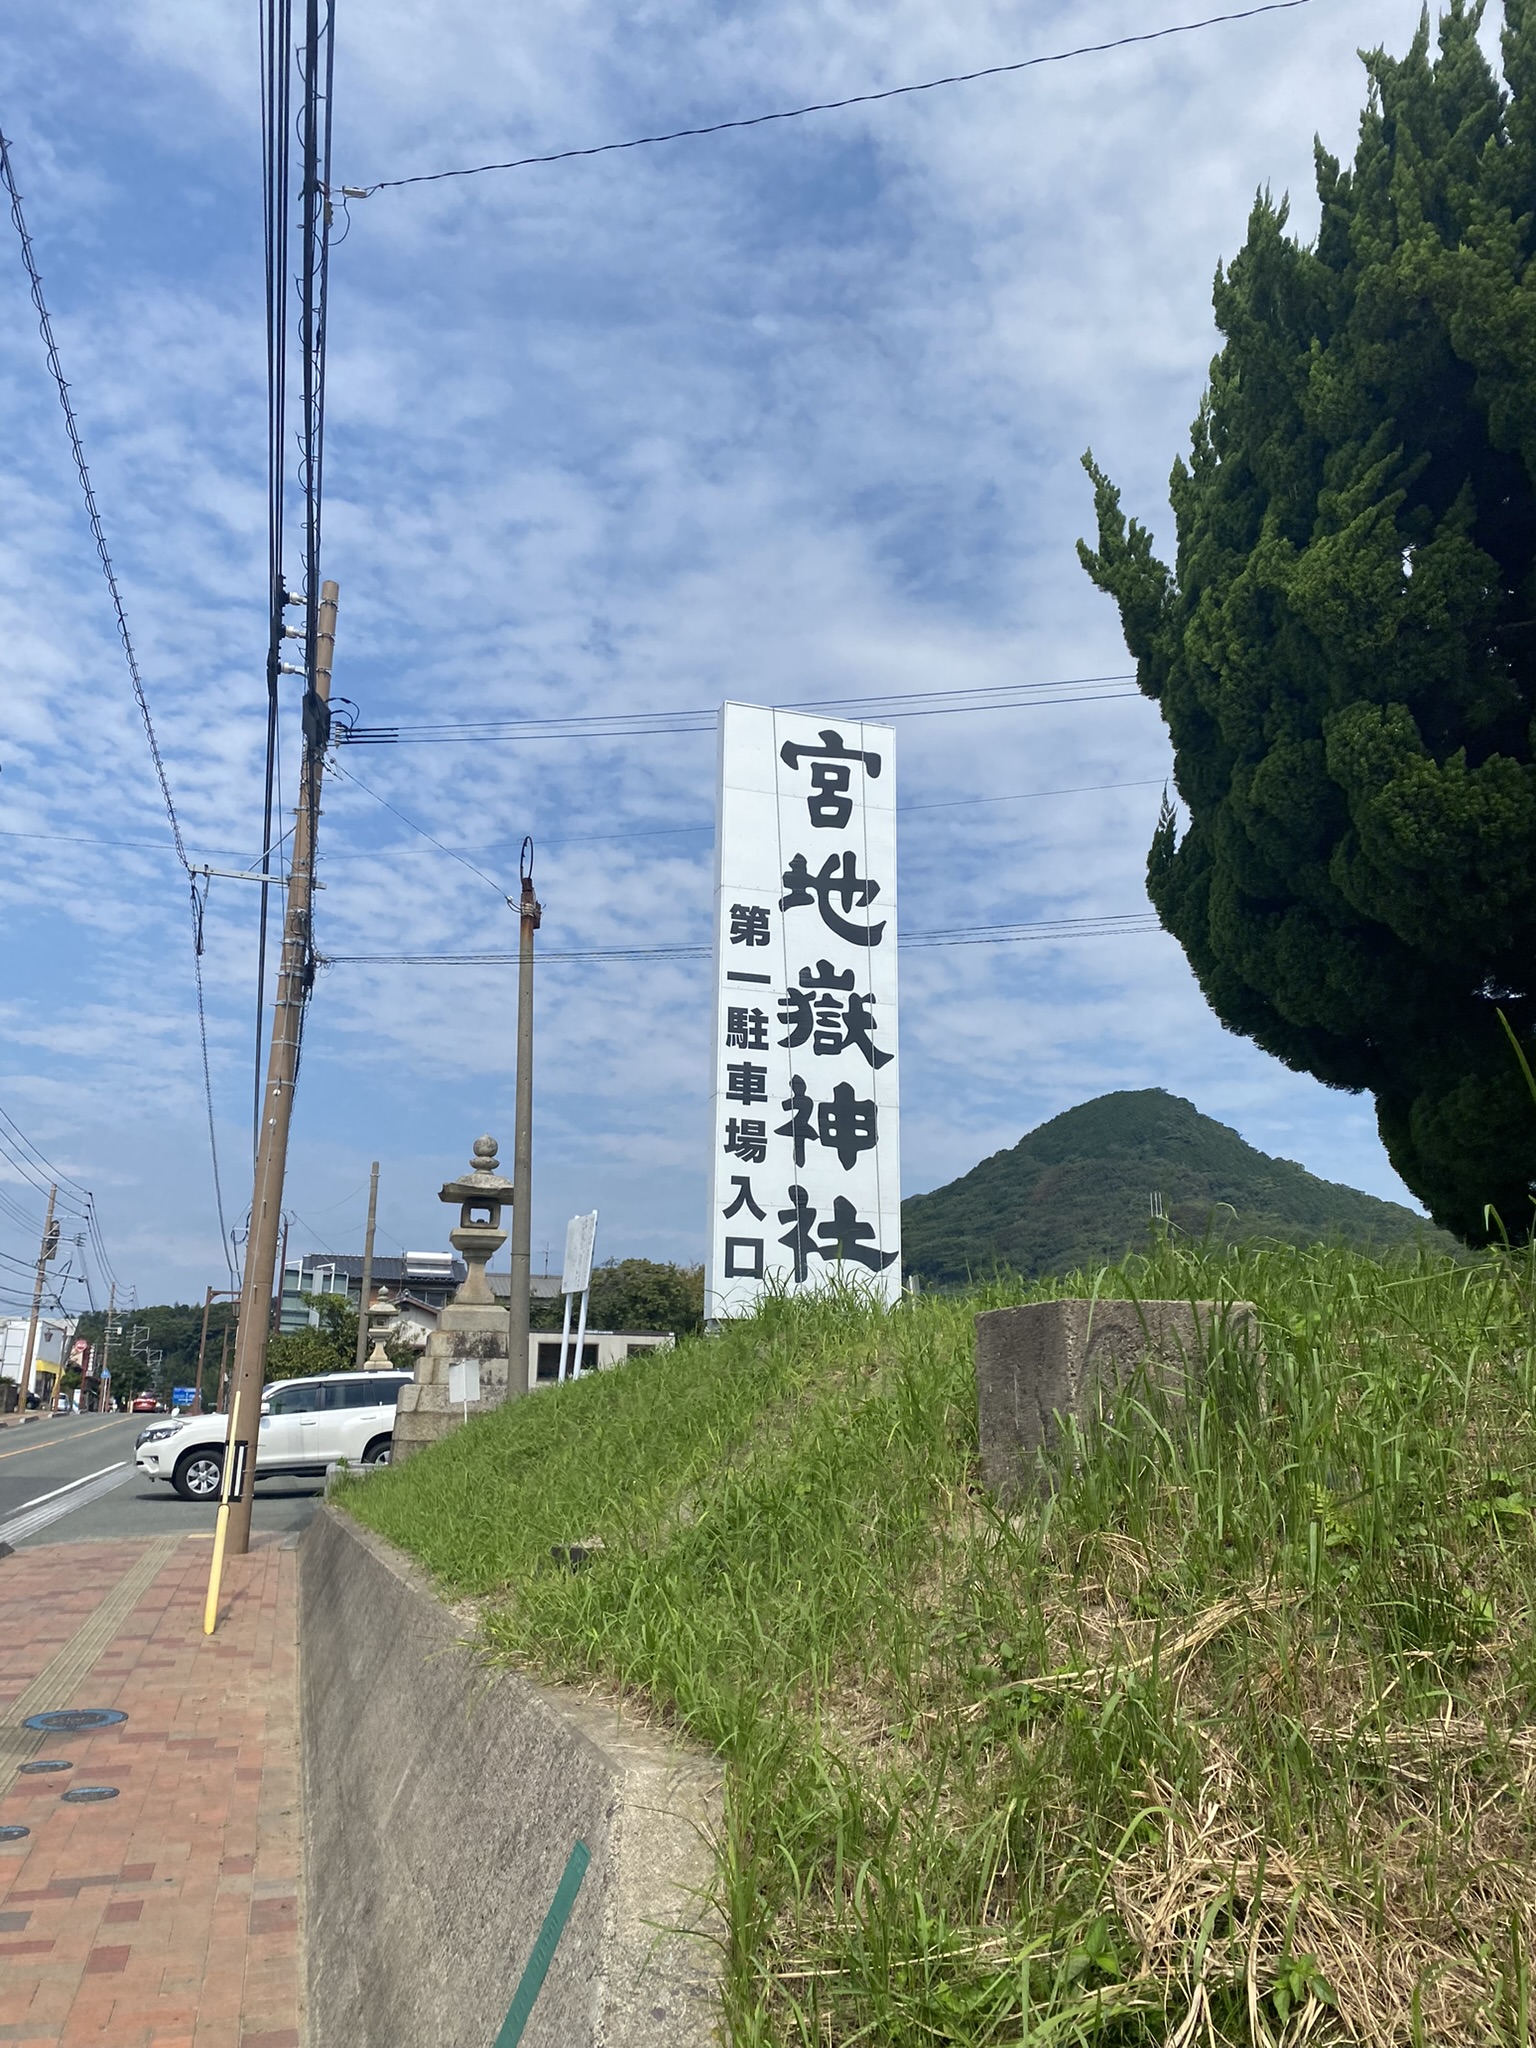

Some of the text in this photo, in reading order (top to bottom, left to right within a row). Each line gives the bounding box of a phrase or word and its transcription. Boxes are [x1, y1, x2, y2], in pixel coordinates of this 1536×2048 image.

[722, 903, 771, 1280] 第一駐車場入口
[774, 729, 899, 1283] 宮地嶽神社
